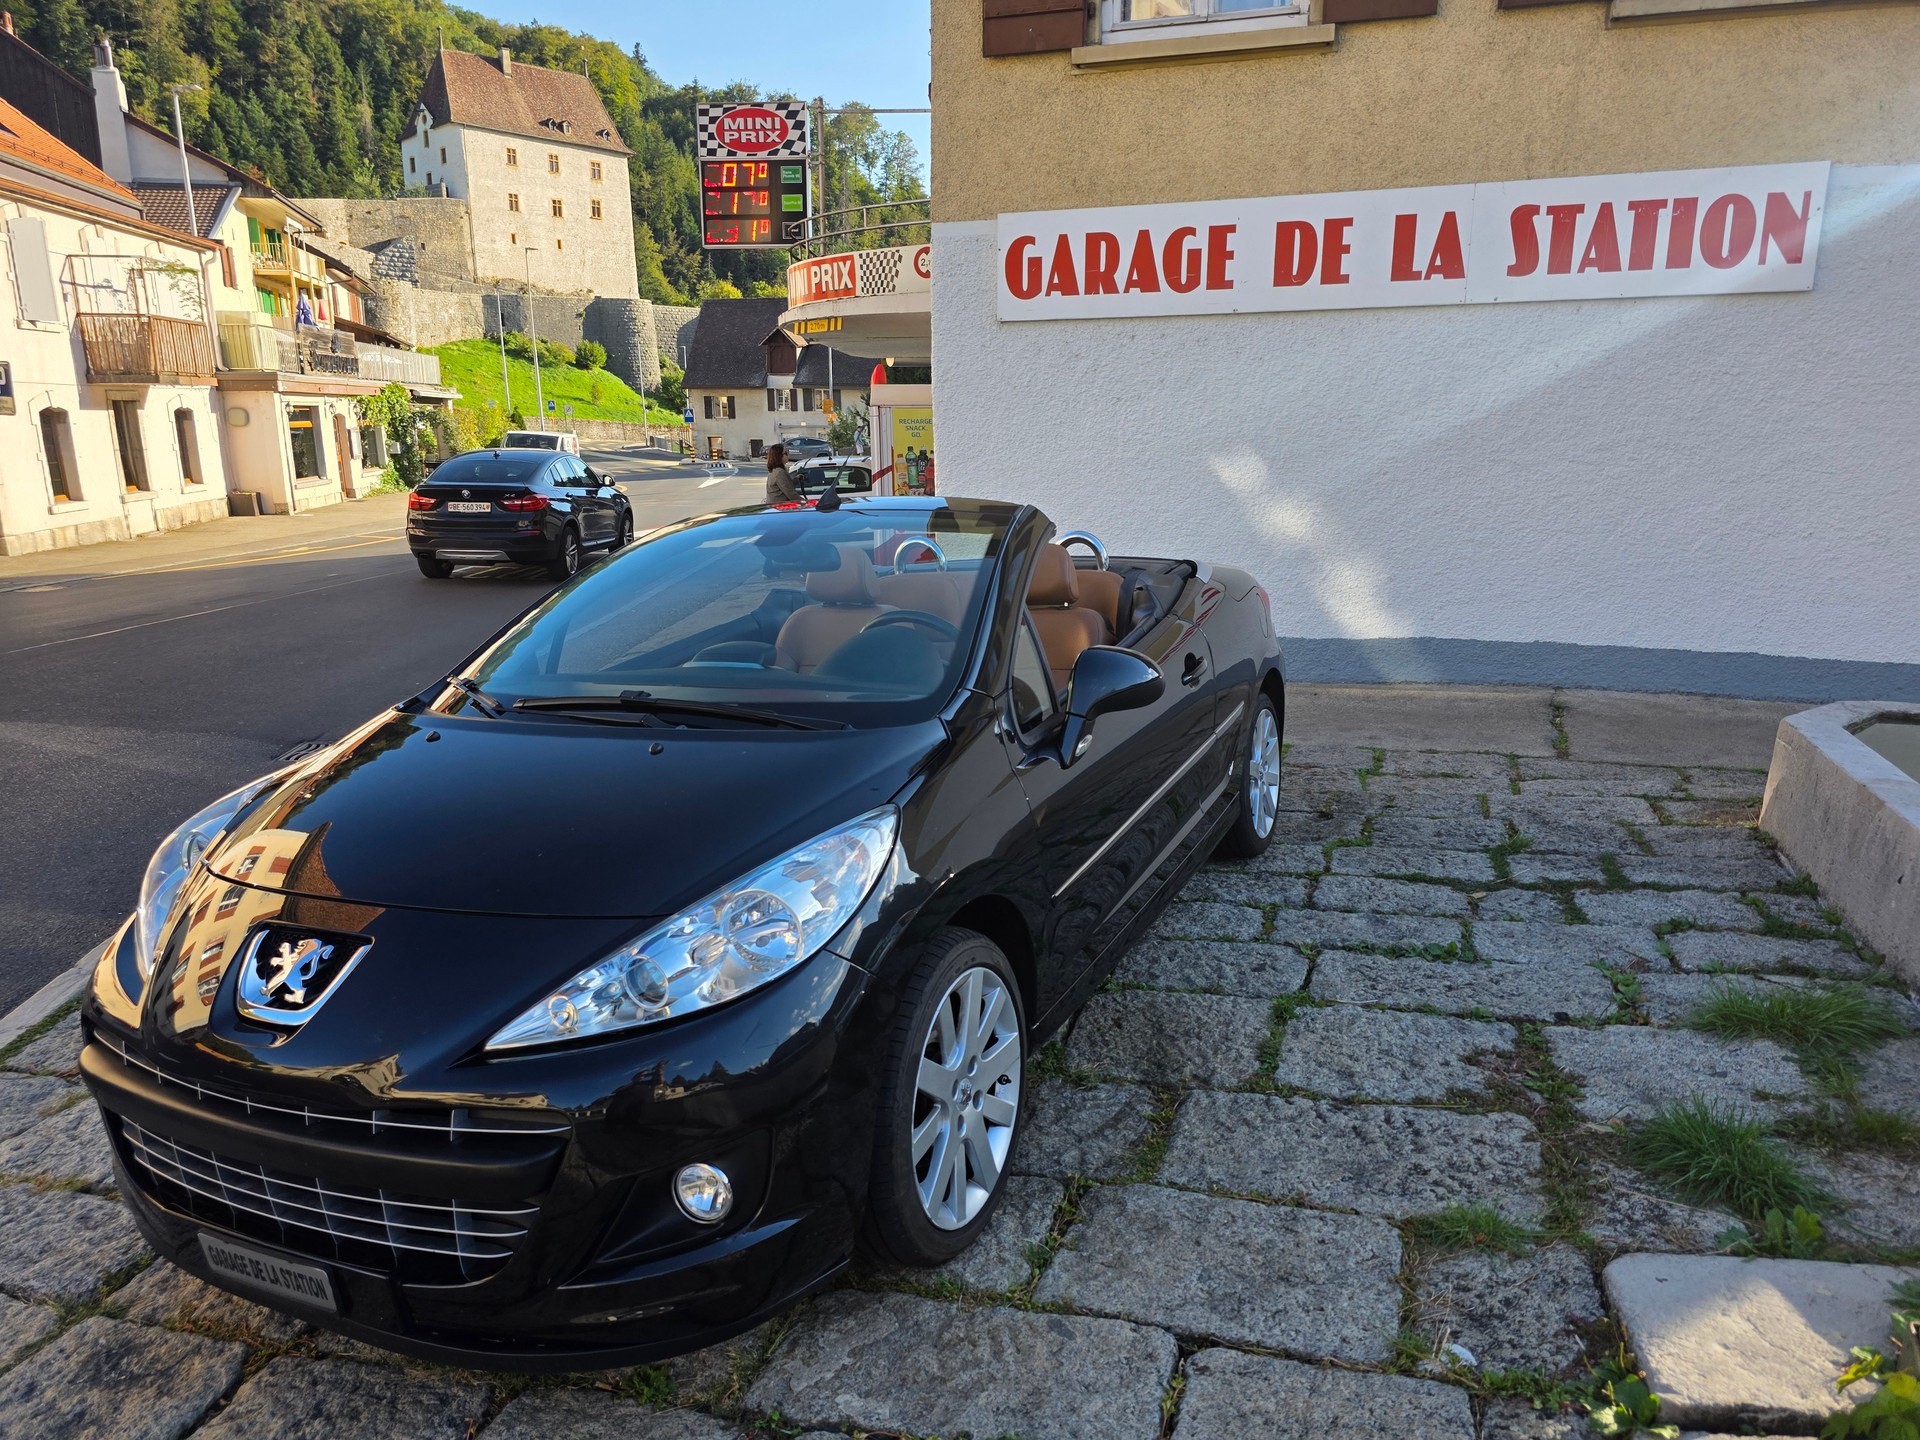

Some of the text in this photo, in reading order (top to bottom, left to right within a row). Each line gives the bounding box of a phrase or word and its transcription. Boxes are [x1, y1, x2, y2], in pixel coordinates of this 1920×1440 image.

[723, 117, 780, 130] MINI
[724, 131, 781, 143] PRIX
[1005, 190, 1812, 300] GARAGE DE LA STATION
[811, 260, 853, 294] PRIX
[208, 1245, 329, 1301] GARAGE DE LA STATION
